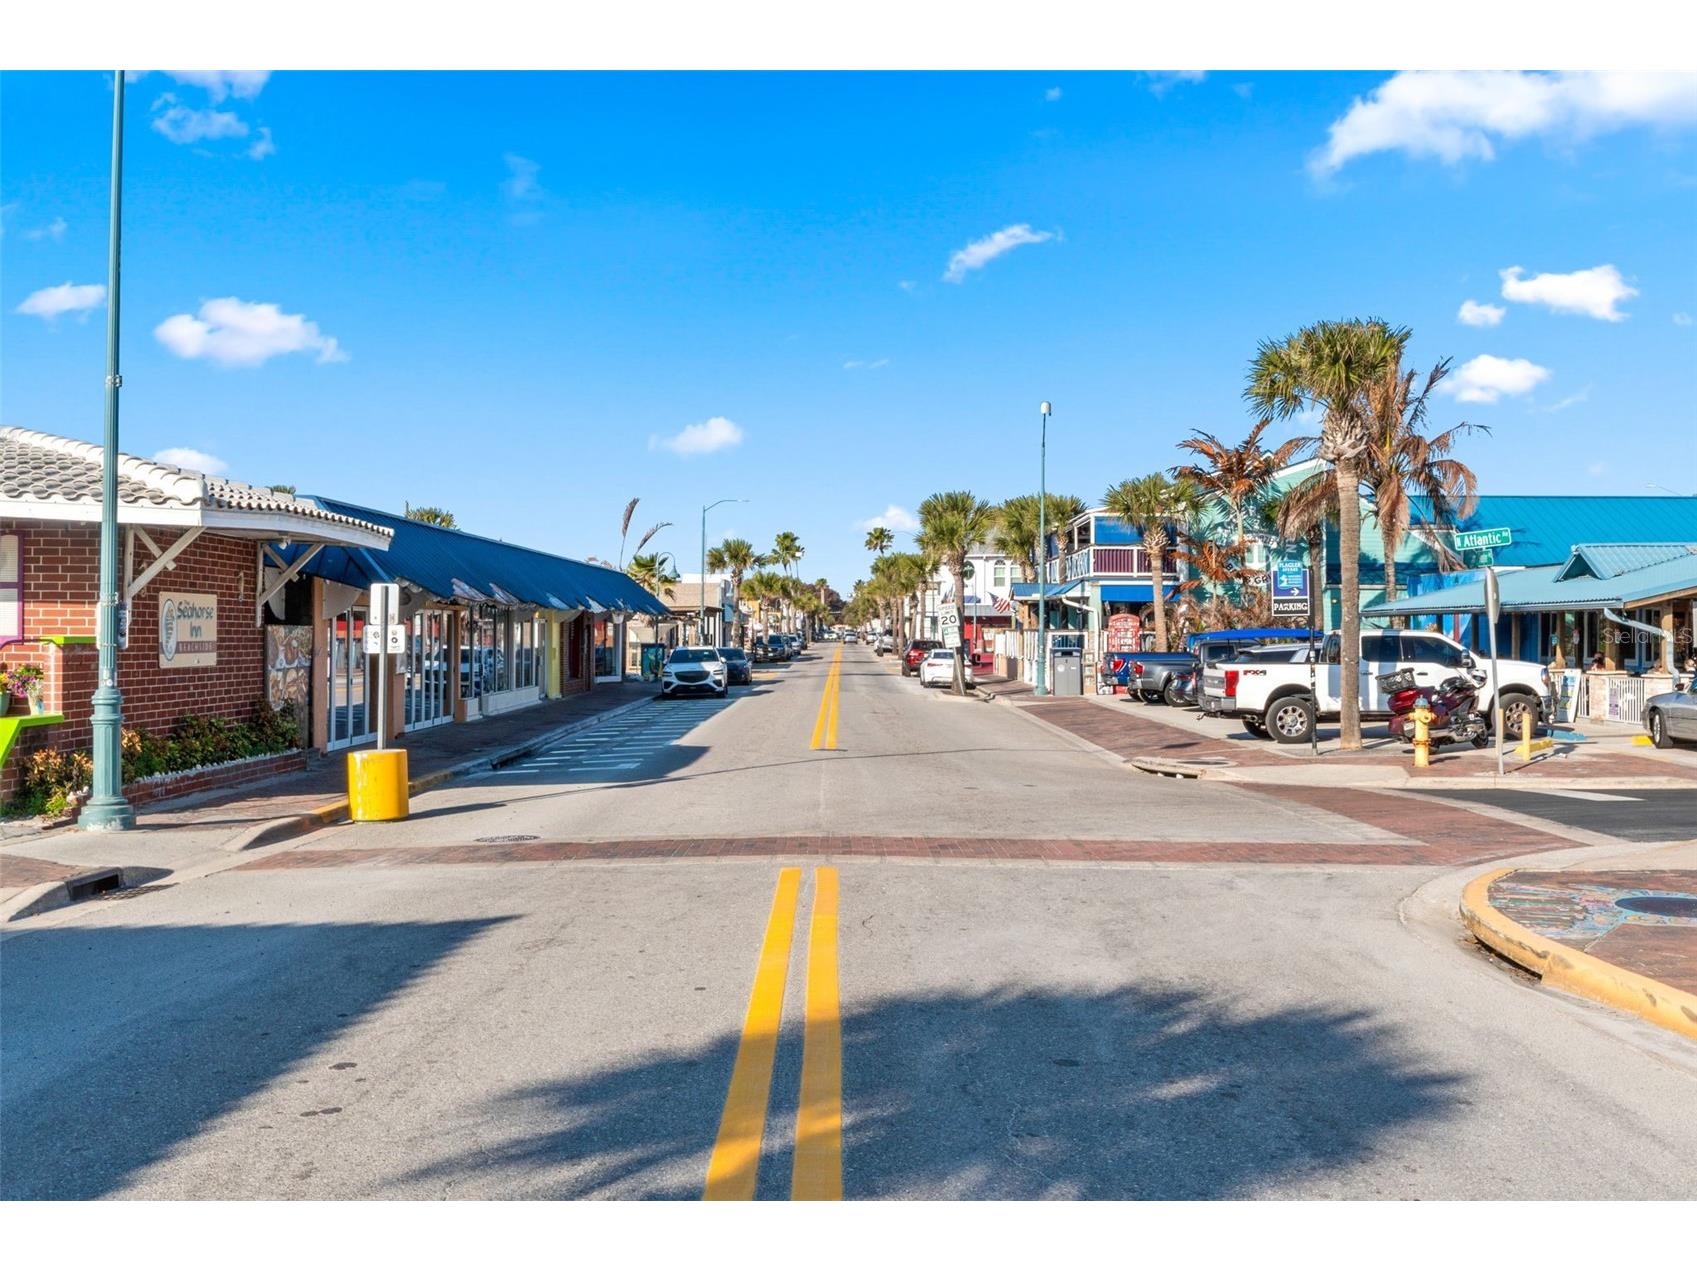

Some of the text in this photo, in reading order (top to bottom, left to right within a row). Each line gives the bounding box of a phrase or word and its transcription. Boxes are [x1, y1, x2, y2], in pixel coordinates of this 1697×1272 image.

[1463, 532, 1502, 547] Atlantic
[177, 601, 213, 619] Seahorse
[1274, 602, 1308, 611] PARKING
[941, 615, 957, 625] 20
[190, 621, 202, 637] Inn
